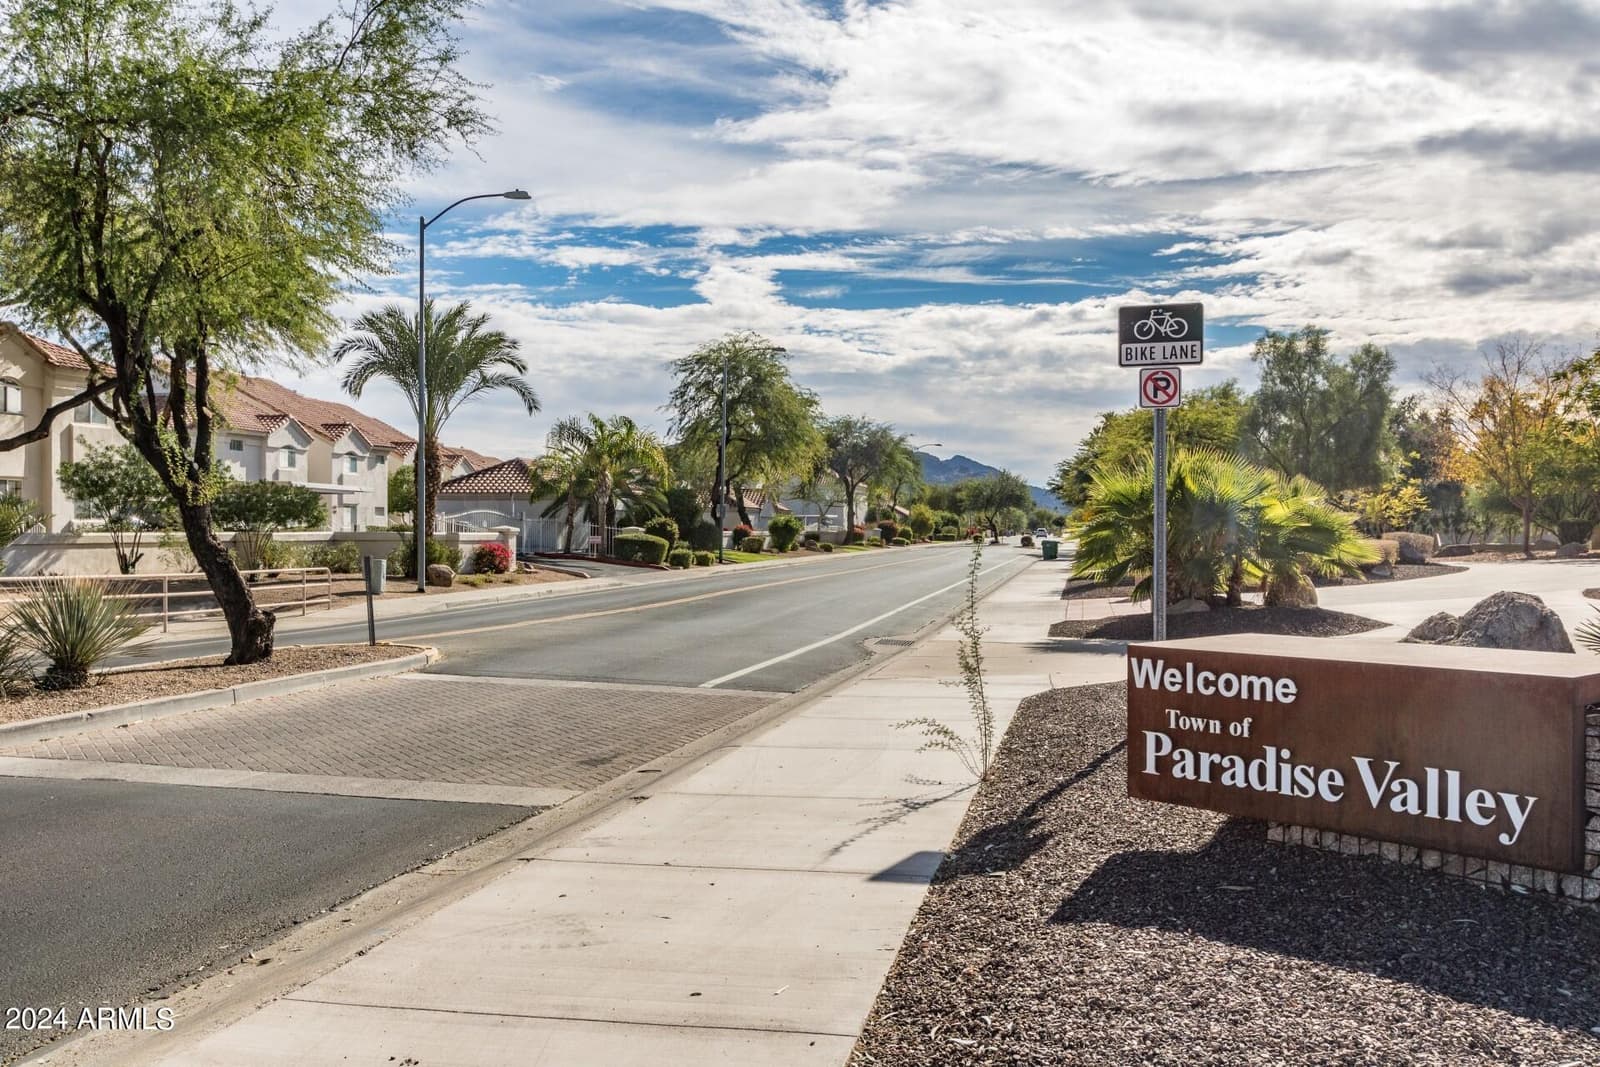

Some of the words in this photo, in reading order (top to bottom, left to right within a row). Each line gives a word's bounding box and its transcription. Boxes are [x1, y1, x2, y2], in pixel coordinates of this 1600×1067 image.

[1125, 346, 1156, 361] BIKE
[1162, 344, 1197, 360] LANE
[1151, 376, 1171, 399] P
[1130, 657, 1298, 704] Welcome
[1165, 708, 1222, 735] Town
[1229, 716, 1253, 738] of
[1141, 730, 1344, 802] Paradise
[1351, 756, 1538, 846] Valley
